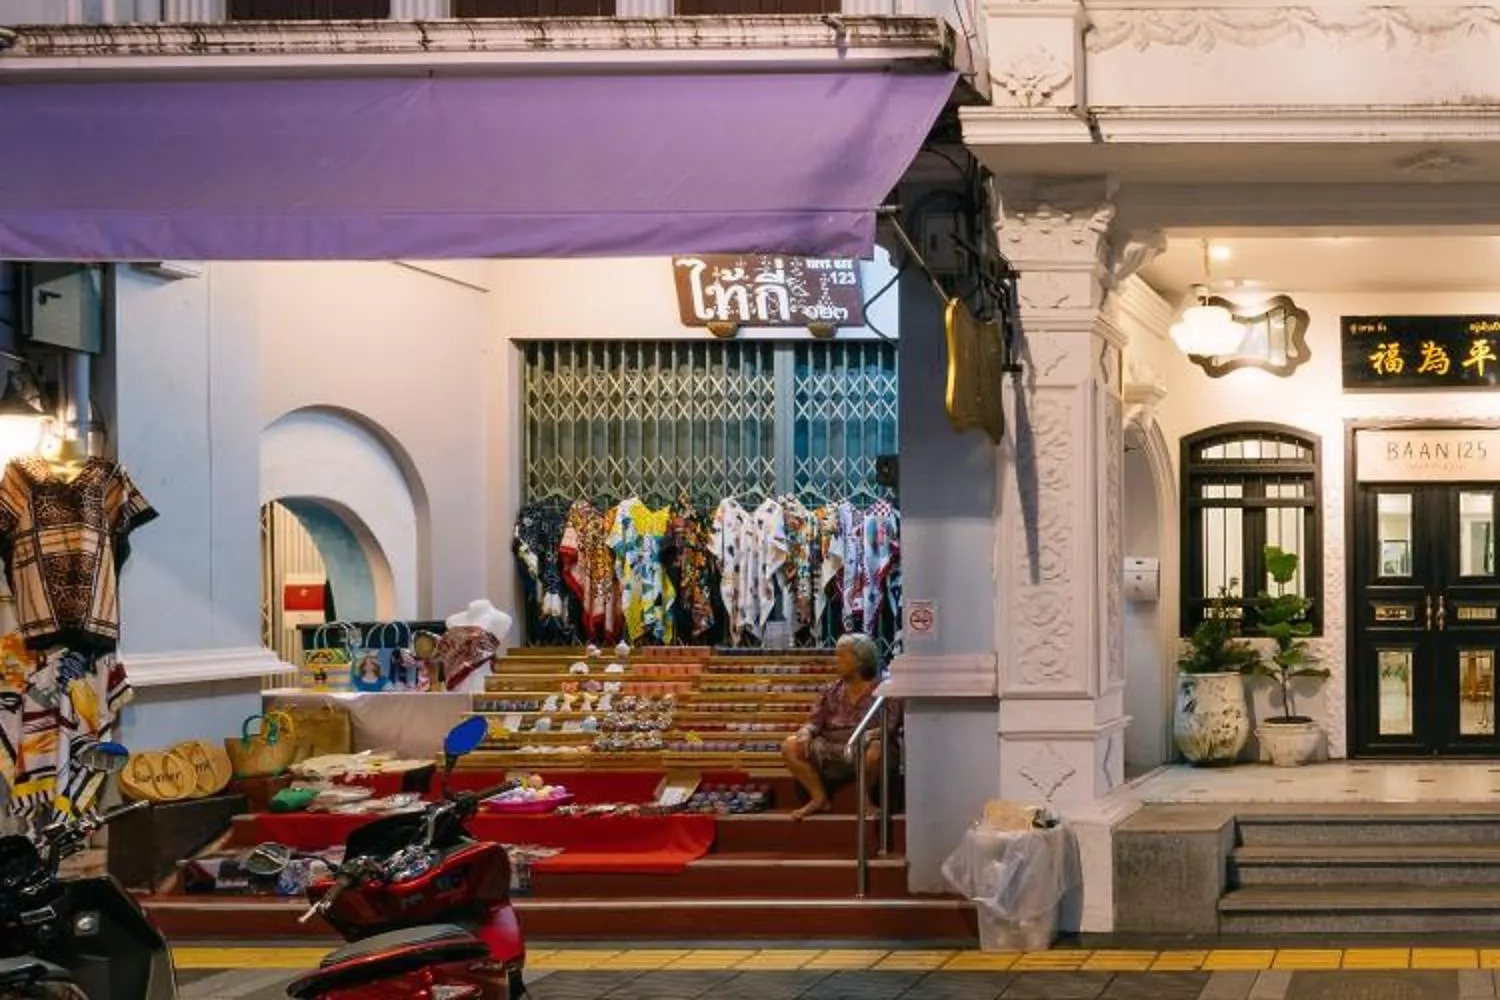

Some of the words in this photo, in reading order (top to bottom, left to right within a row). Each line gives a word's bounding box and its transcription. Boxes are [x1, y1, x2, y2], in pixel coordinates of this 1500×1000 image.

[831, 271, 855, 285] 123
[1387, 441, 1449, 460] BAAN
[1457, 441, 1487, 460] 125
